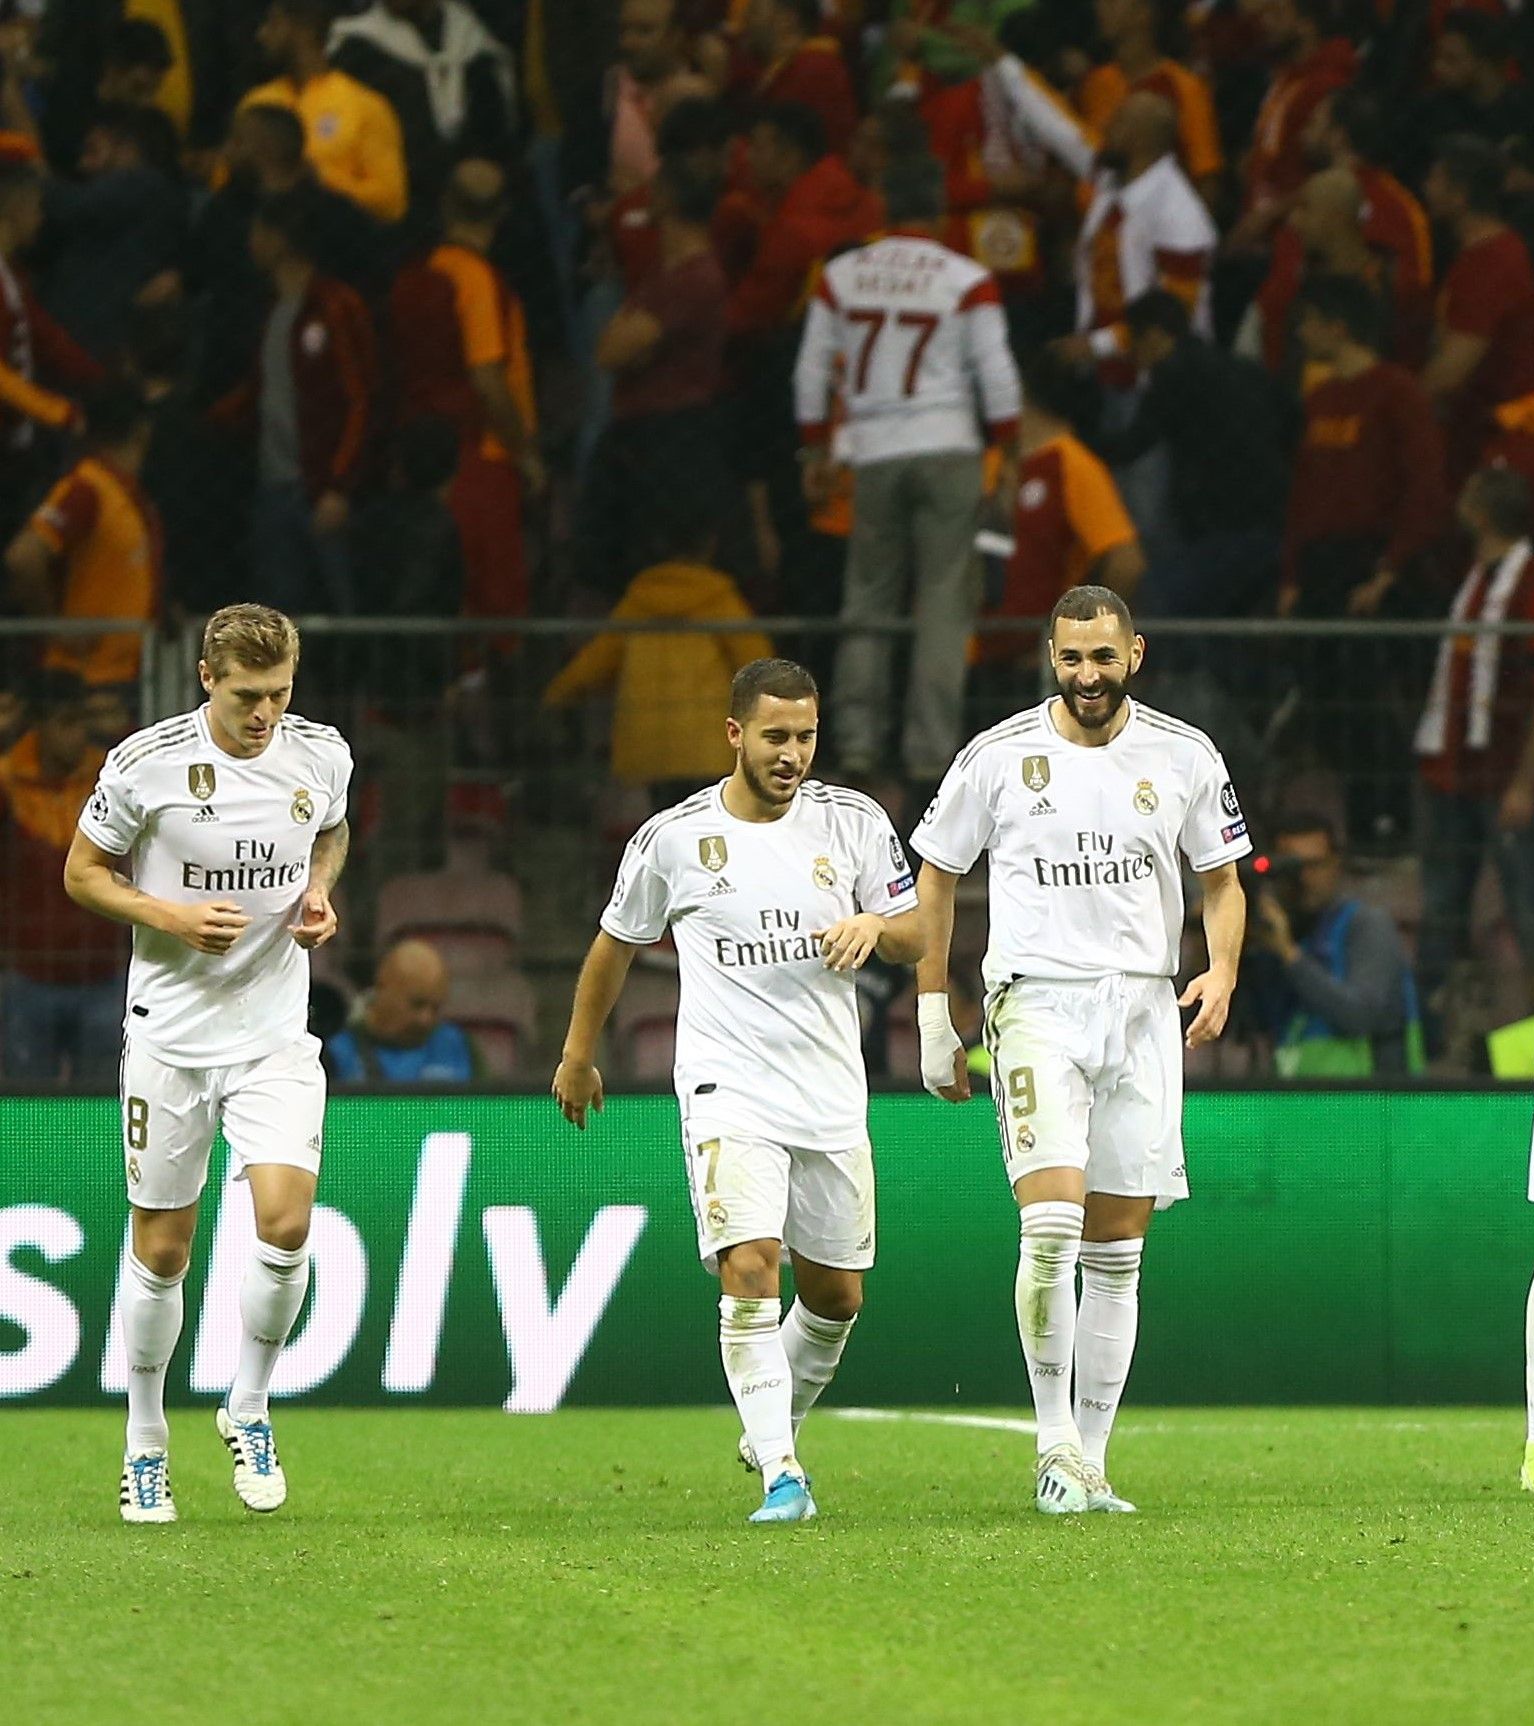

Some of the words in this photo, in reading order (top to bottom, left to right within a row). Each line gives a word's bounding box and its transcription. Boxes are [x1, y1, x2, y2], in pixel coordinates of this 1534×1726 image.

[846, 309, 940, 397] 77
[1029, 808, 1057, 816] adidas
[234, 839, 275, 862] Fly
[1076, 831, 1114, 855] Fly
[1034, 854, 1154, 886] Emirates
[760, 908, 800, 931] Fly
[1008, 1065, 1037, 1119] 9
[127, 1095, 149, 1151] 8
[697, 1137, 721, 1194] 7
